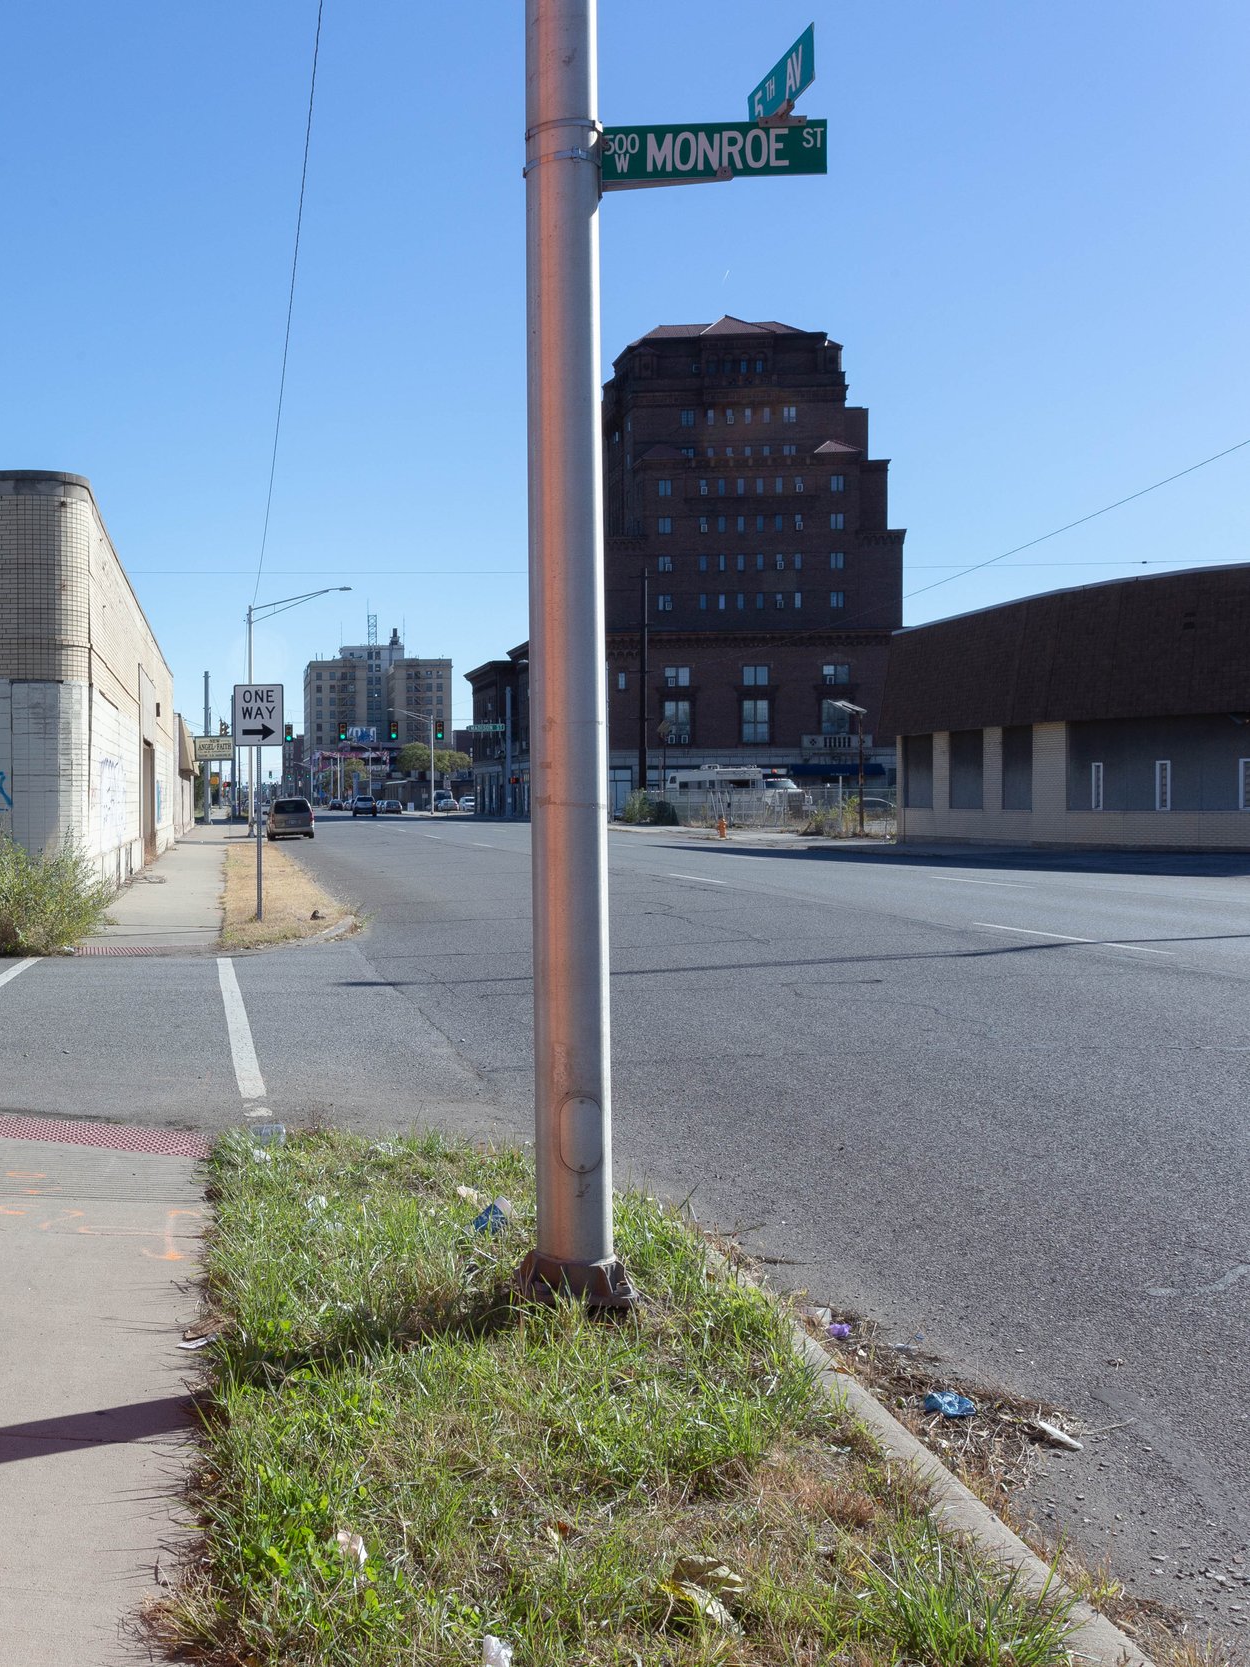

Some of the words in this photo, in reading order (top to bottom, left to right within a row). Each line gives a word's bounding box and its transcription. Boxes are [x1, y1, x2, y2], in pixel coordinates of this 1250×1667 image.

[785, 45, 803, 99] AV
[604, 133, 640, 155] 500
[646, 127, 790, 173] MONROE
[802, 127, 825, 148] ST
[614, 153, 630, 174] W
[243, 689, 275, 703] ONE
[241, 706, 276, 720] WAY
